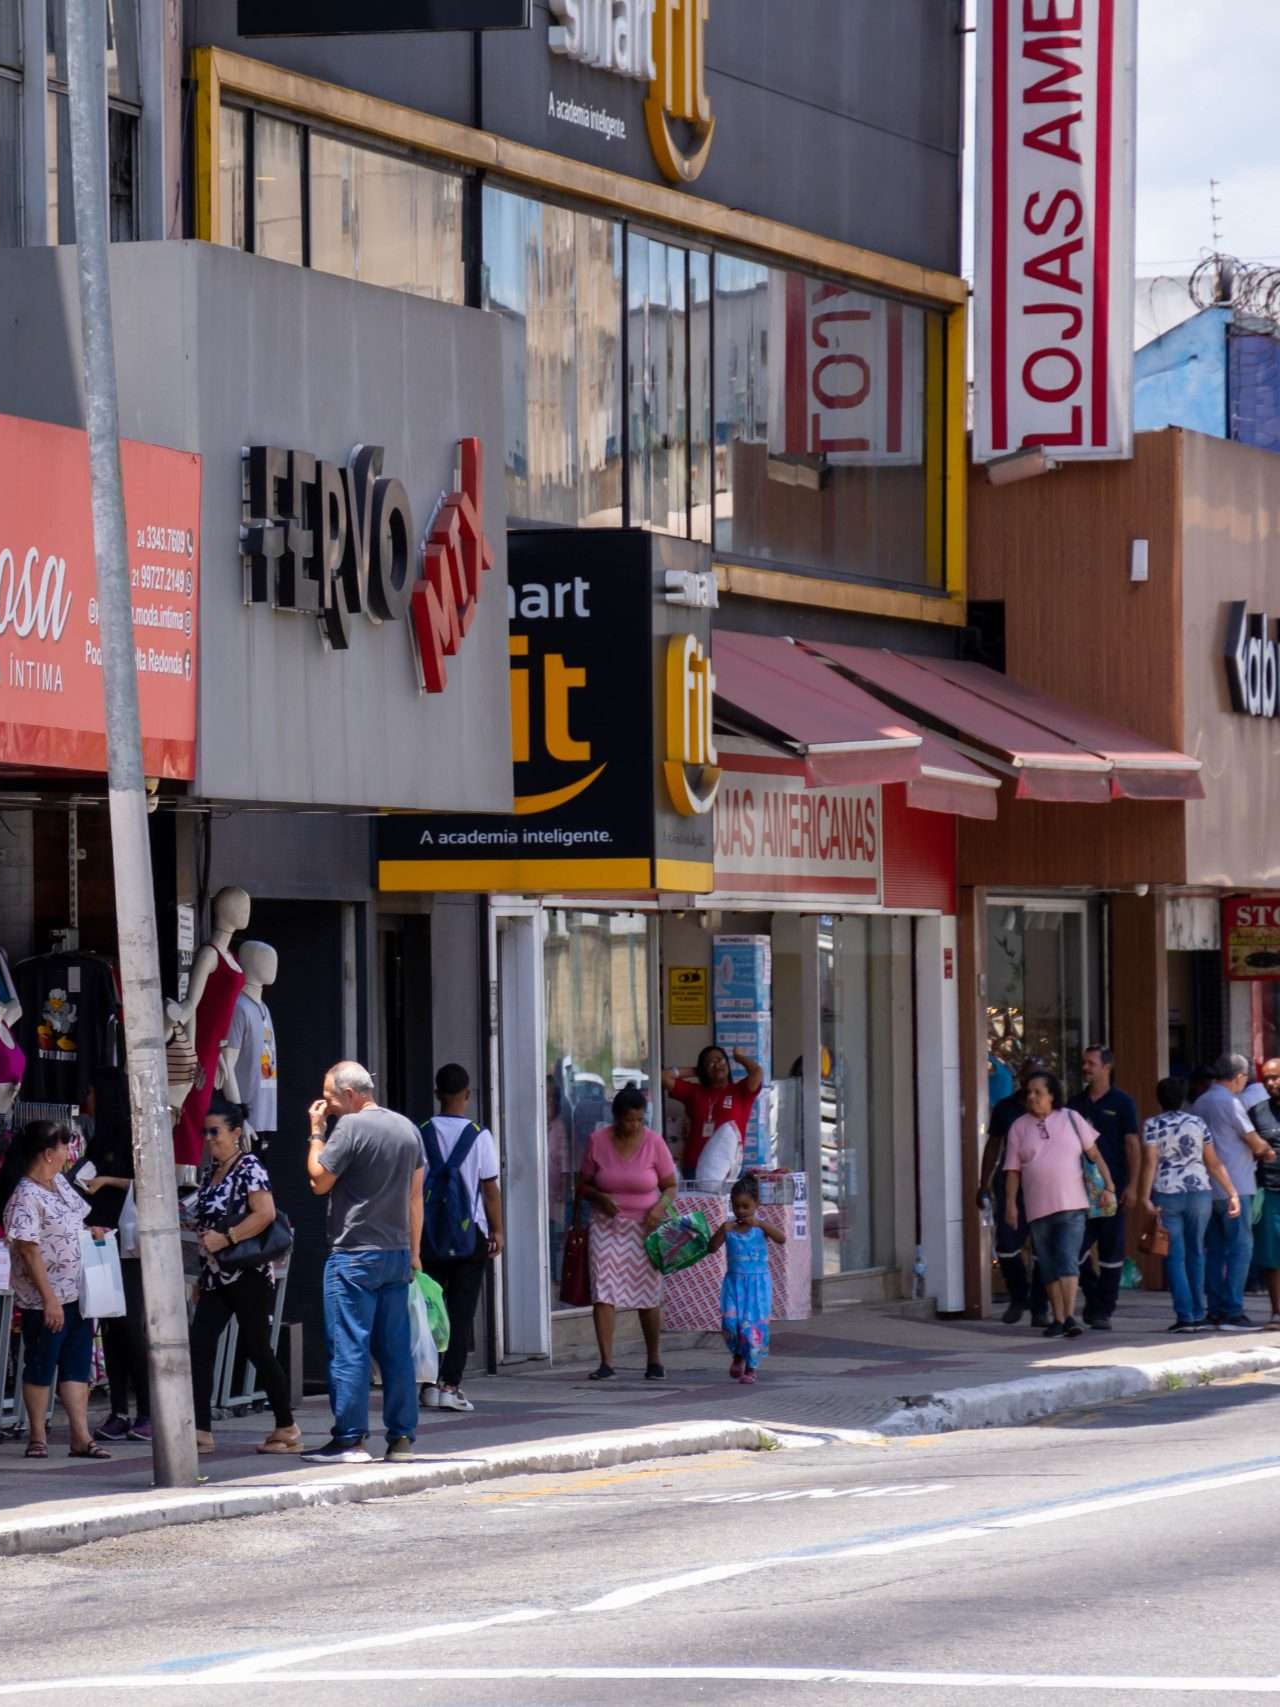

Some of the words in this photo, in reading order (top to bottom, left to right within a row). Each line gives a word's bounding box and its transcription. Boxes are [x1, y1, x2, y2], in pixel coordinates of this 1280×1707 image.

[547, 91, 556, 116] A
[556, 97, 589, 128] academia
[588, 105, 627, 141] inteligente.
[1021, 188, 1083, 447] LOJAS
[509, 575, 591, 619] art
[148, 649, 183, 675] Redonda
[419, 828, 434, 845] A
[438, 828, 518, 846] academia
[522, 826, 614, 848] inteligente.
[762, 791, 877, 864] AMERICANAS
